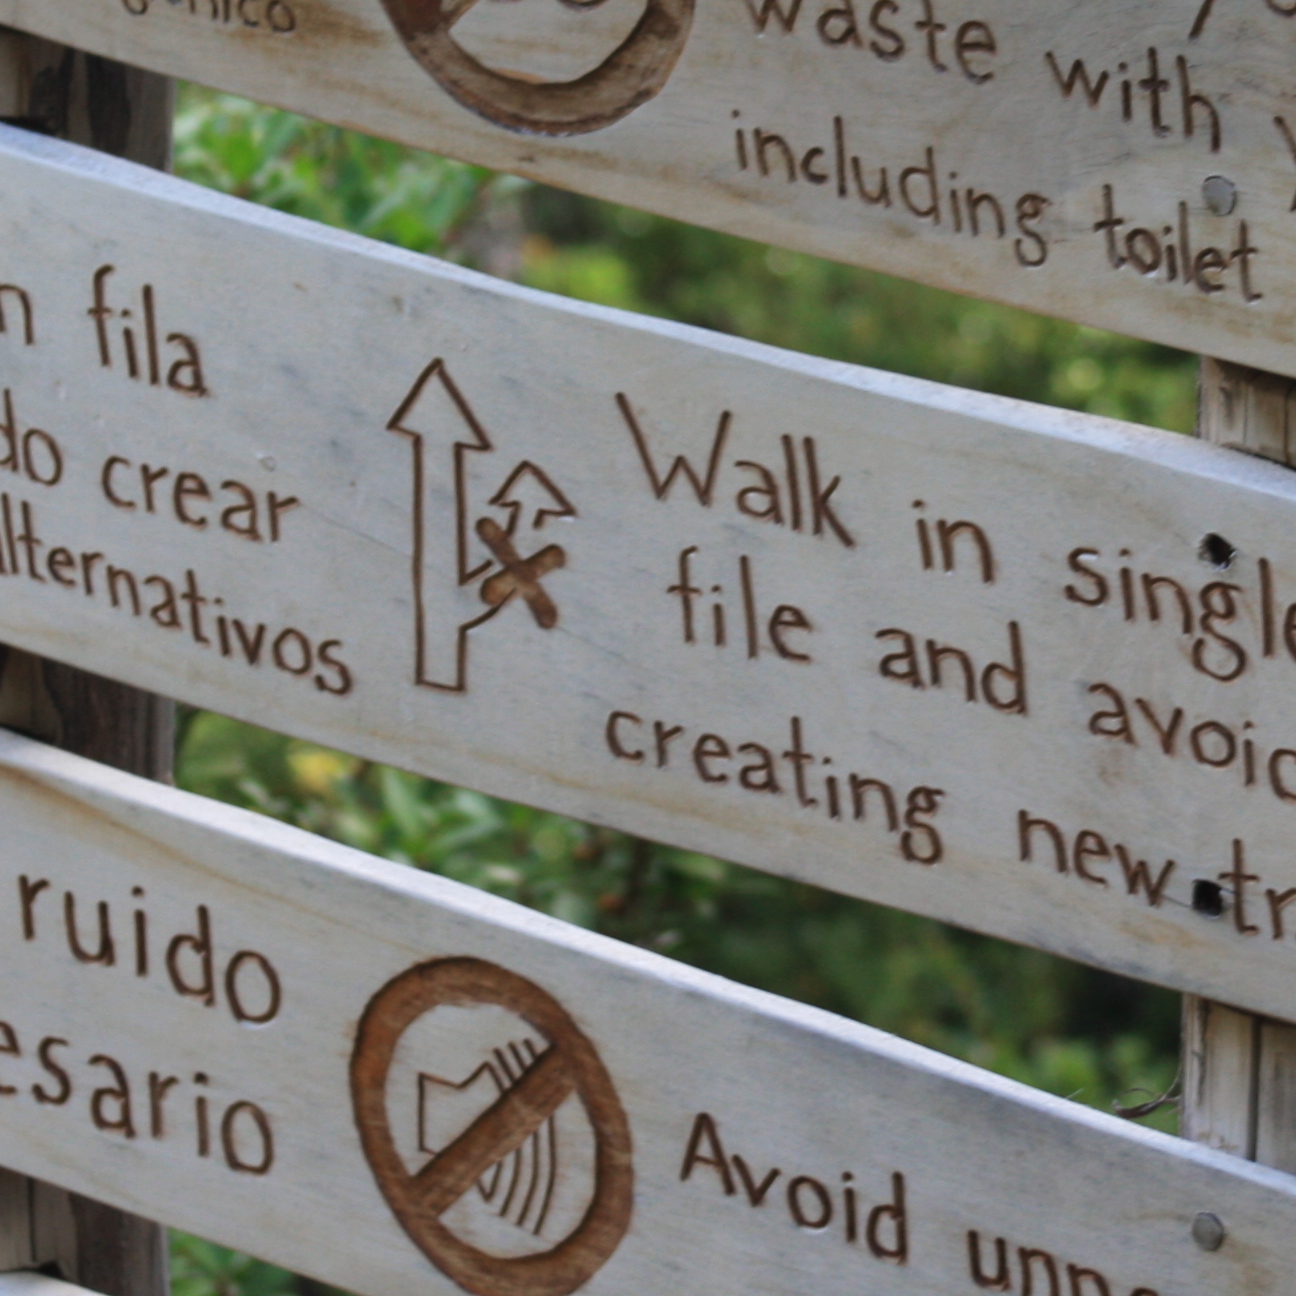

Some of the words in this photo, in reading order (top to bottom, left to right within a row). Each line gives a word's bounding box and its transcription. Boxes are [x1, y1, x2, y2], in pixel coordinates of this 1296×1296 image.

[1046, 46, 1220, 153] with
[729, 109, 1054, 267] including
[1094, 184, 1263, 303] toilet
[88, 264, 210, 399] fila
[102, 455, 300, 544] crear
[614, 391, 856, 548] Walk
[911, 499, 995, 584] in
[668, 545, 813, 662] file
[875, 620, 1030, 716] and
[606, 709, 945, 866] creating
[1017, 808, 1177, 907] new
[17, 874, 282, 1025] ruido
[680, 1110, 911, 1265] Avoid
[965, 1229, 1159, 1296] unn
